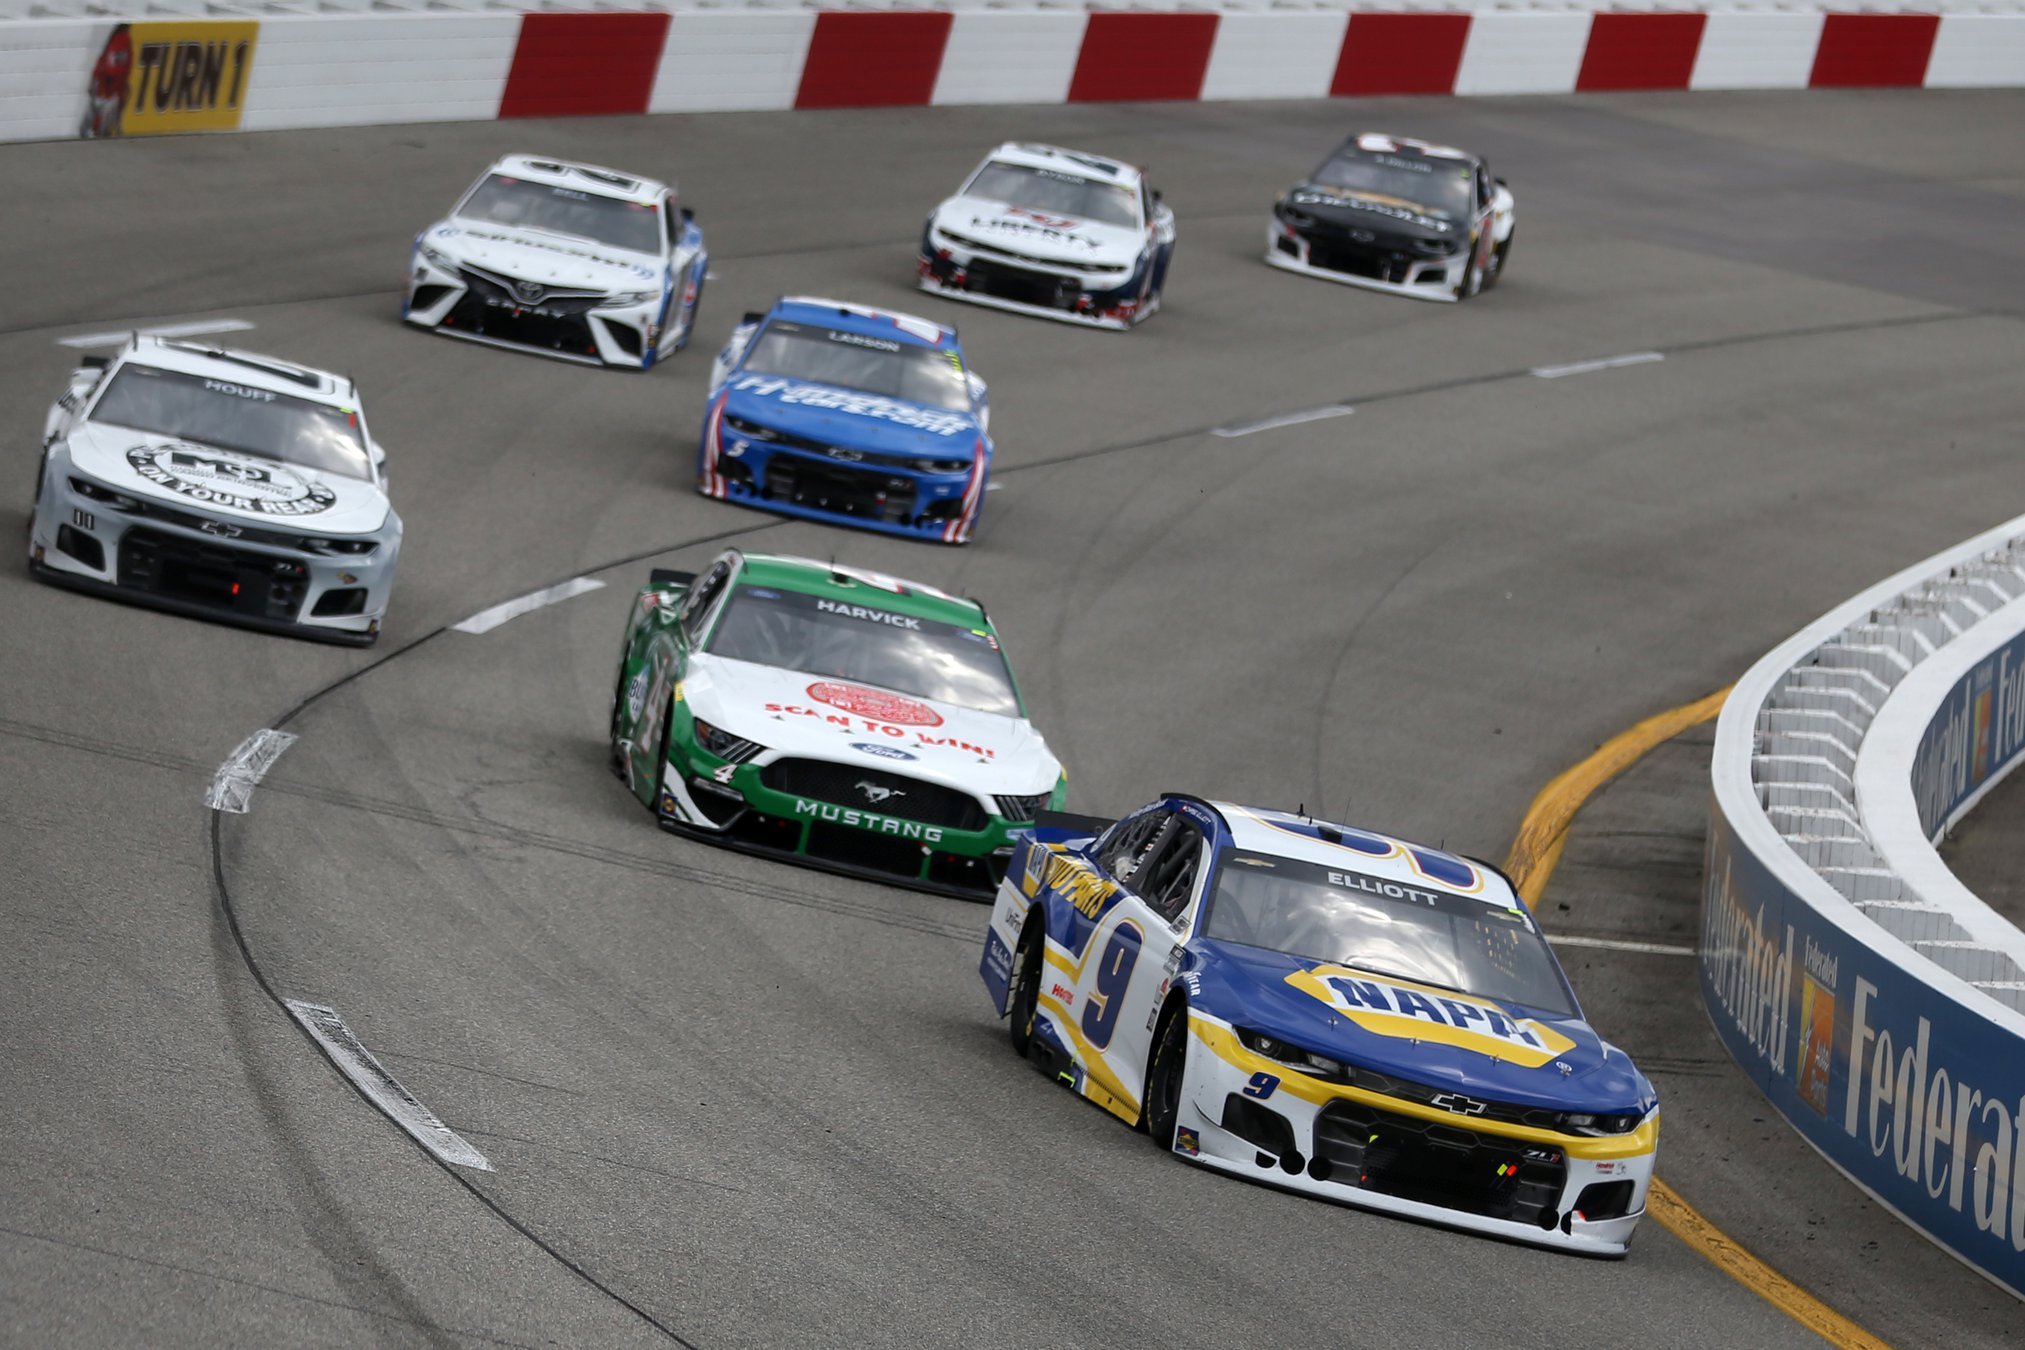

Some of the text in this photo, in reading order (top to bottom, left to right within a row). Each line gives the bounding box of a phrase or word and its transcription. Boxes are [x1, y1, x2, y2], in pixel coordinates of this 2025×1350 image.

[135, 40, 249, 114] TURN 1
[828, 330, 901, 354] LARSON
[204, 378, 278, 403] HOUFF
[727, 439, 750, 458] 5
[138, 465, 173, 485] ON
[175, 480, 254, 511] YOUR
[816, 599, 921, 631] HARVICK
[764, 703, 995, 759] SCAN TO WIN!
[861, 742, 906, 760] Ford
[713, 762, 738, 785] 4
[795, 798, 943, 843] MUSTANG
[1327, 870, 1439, 907] ELLIOTT
[1804, 935, 1838, 989] Federated
[1081, 916, 1146, 1052] 9
[1327, 975, 1542, 1048] NAPA
[1243, 1071, 1282, 1100] 9
